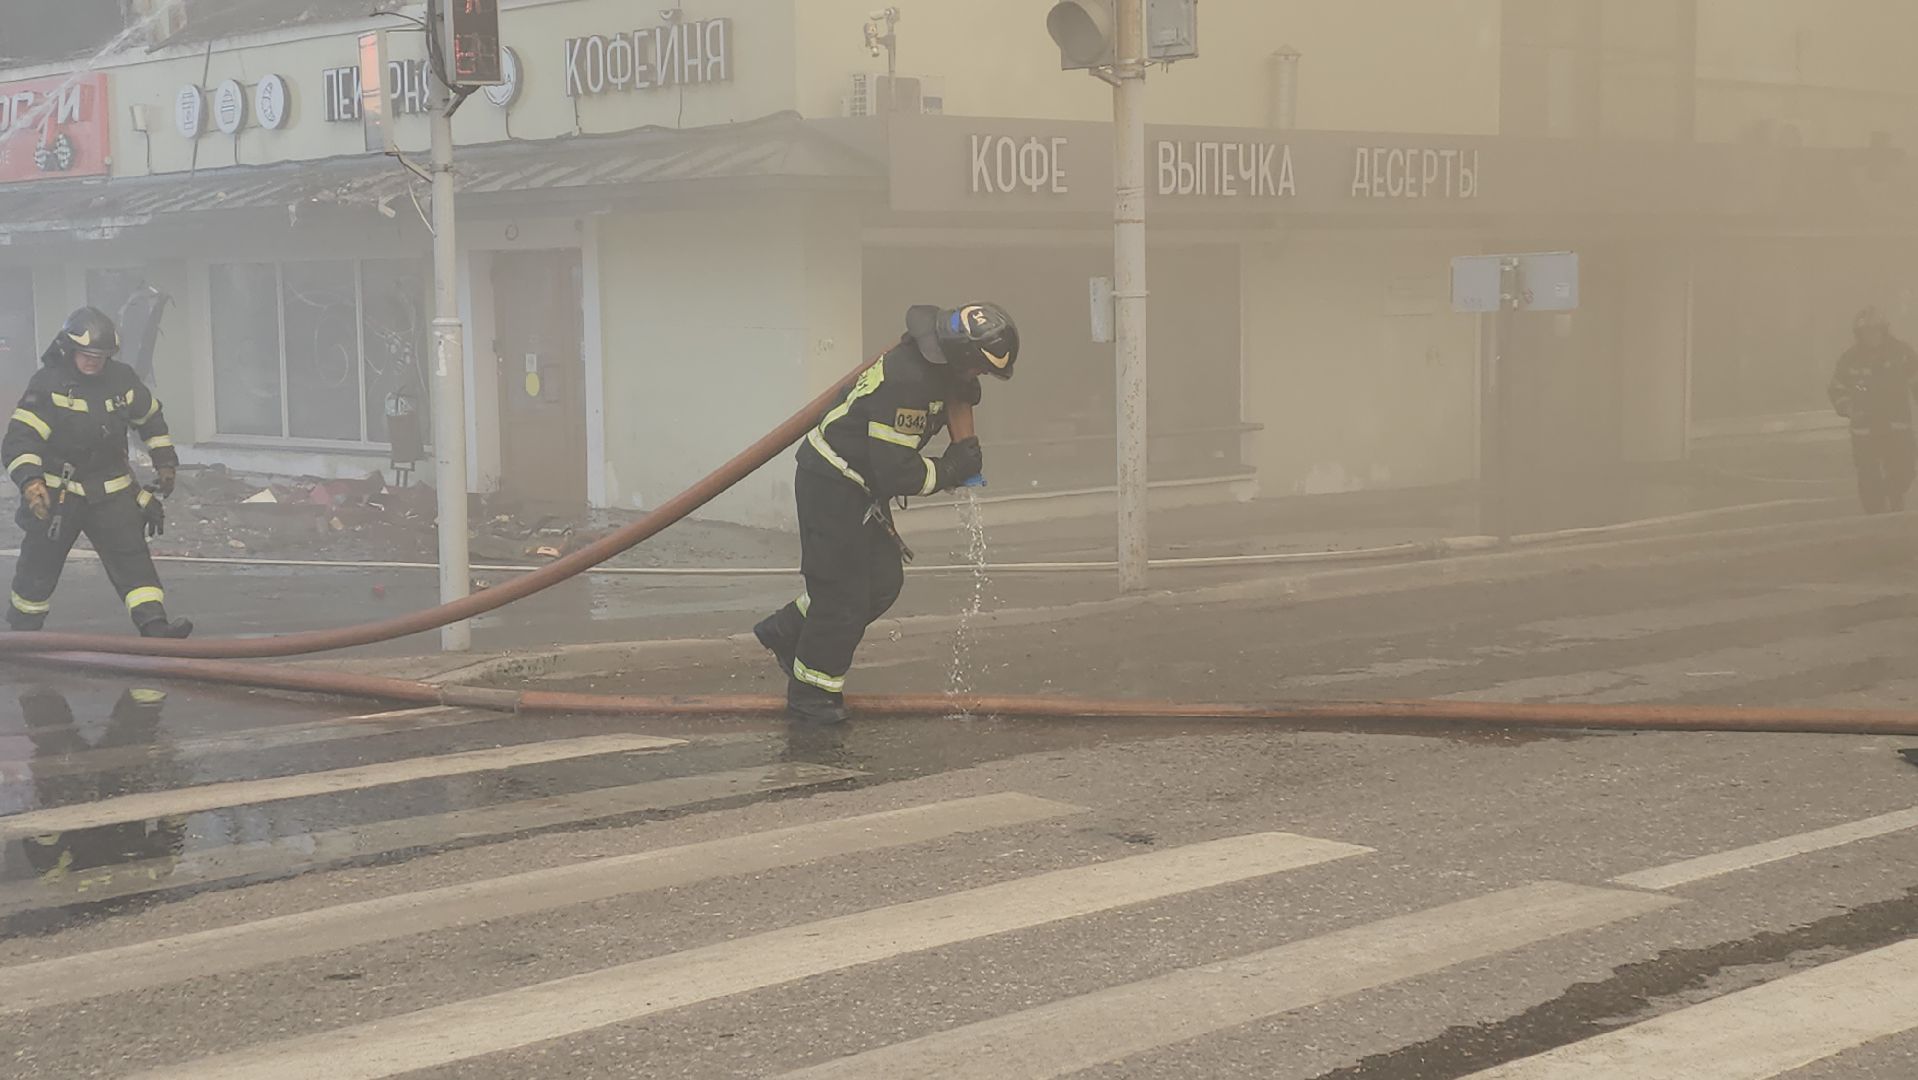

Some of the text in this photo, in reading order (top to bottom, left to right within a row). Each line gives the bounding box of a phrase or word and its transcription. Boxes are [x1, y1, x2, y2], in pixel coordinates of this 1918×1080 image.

[565, 11, 729, 97] КОФЕЙНЯ
[323, 59, 431, 121] ПЕКРН
[970, 134, 1069, 194] КОФЕ
[1157, 140, 1296, 197] ВЫПЕЧКА
[1351, 146, 1479, 199] ДЕСЕРТЫ
